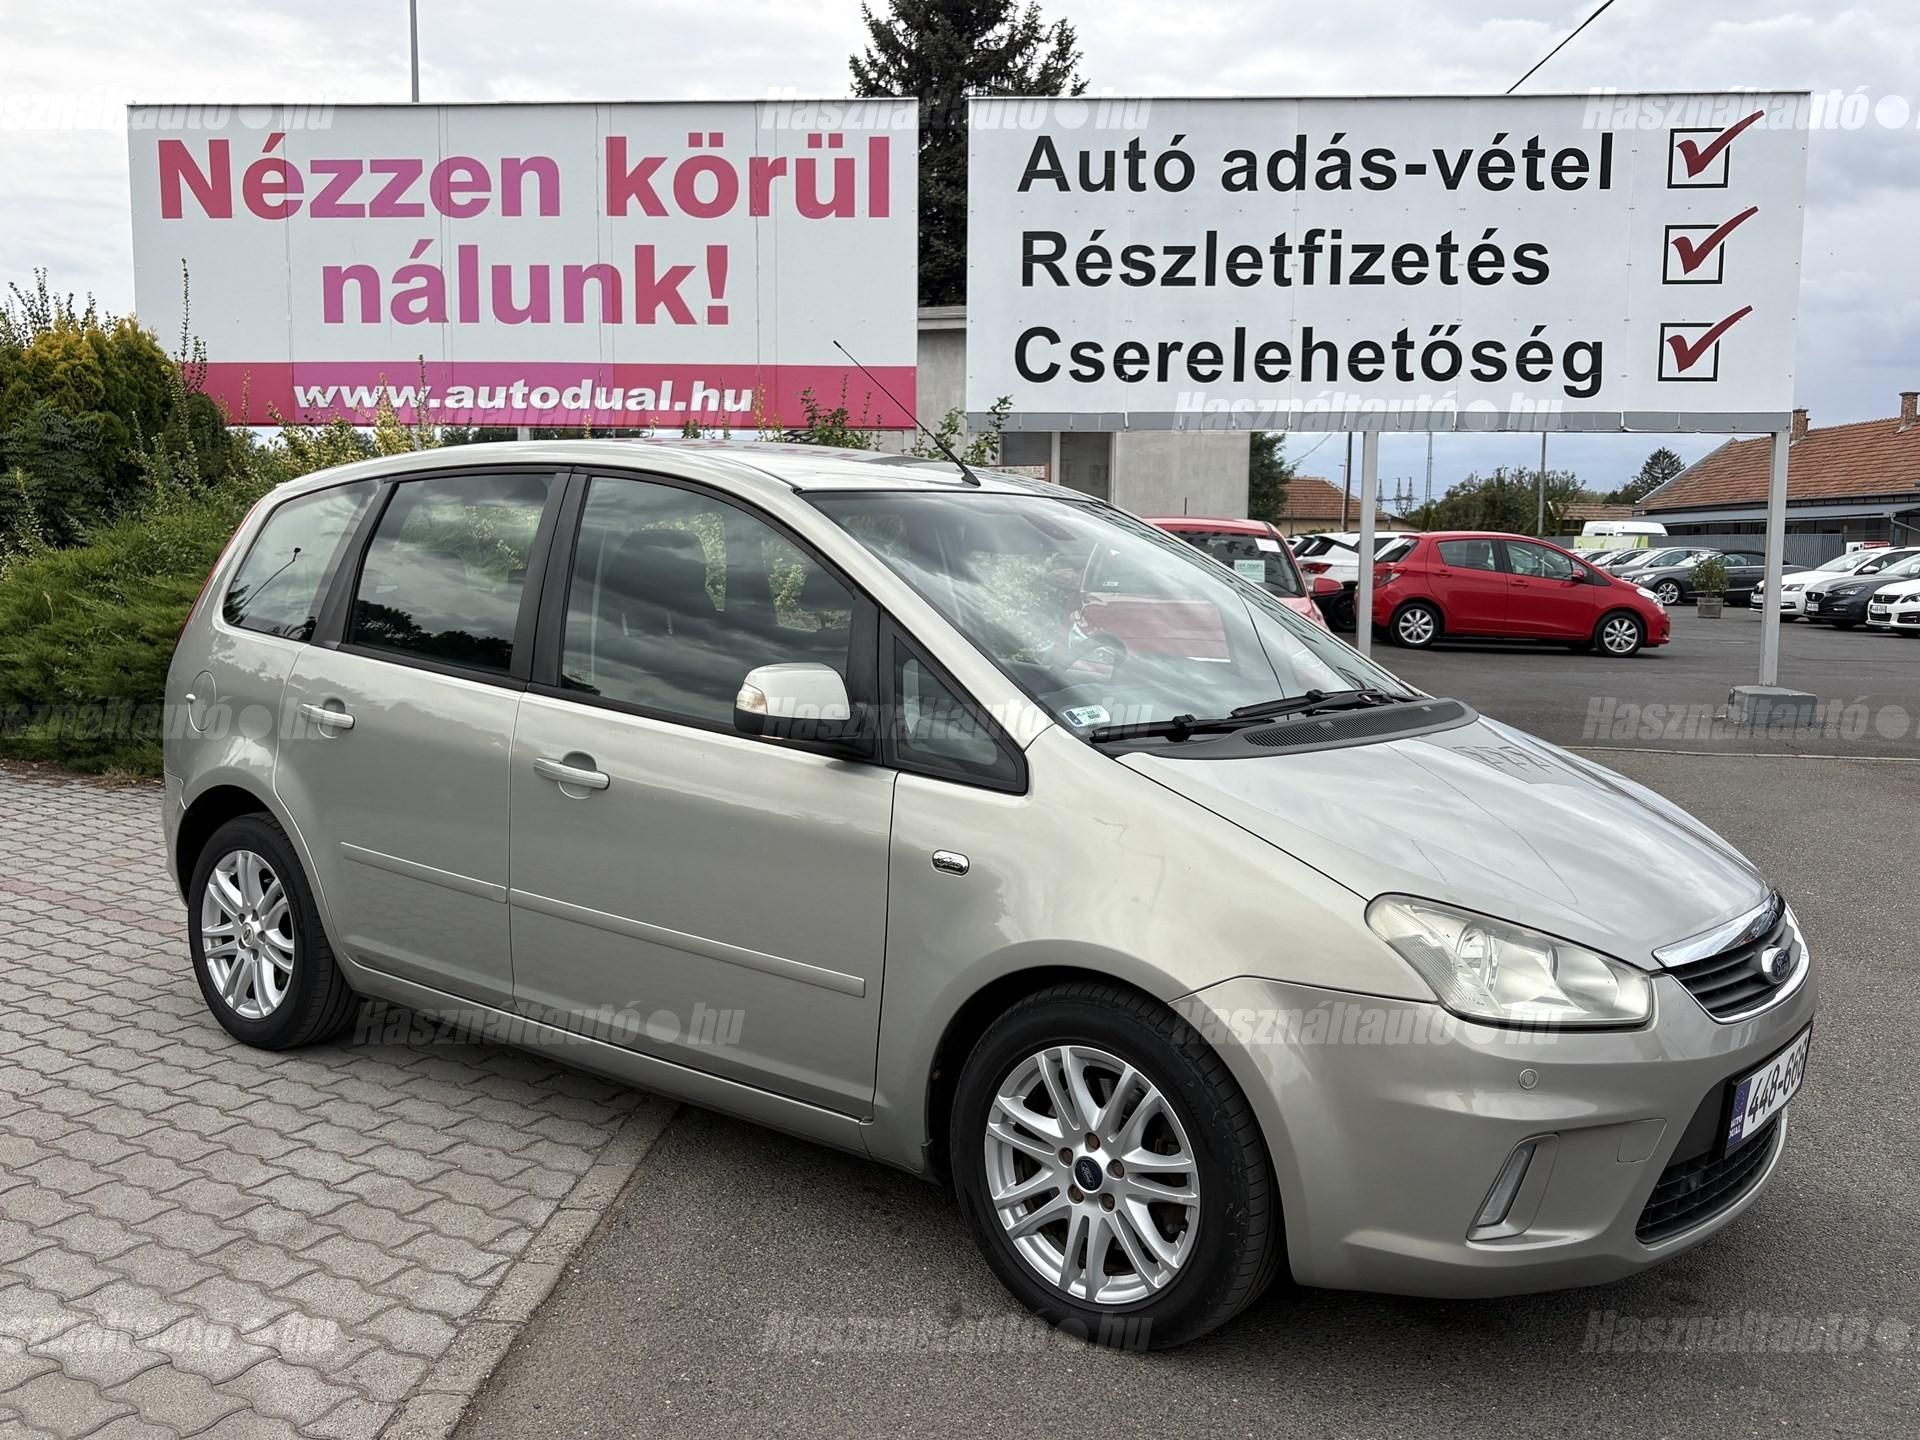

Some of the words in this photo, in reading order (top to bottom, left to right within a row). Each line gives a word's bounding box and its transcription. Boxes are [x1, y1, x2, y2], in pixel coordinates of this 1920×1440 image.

[159, 133, 559, 219] Nézzen
[607, 133, 888, 218] körül
[1018, 135, 1194, 192] Autó
[1222, 133, 1613, 192] adás-vétel
[325, 241, 727, 324] nálunk!
[1023, 228, 1549, 287] Részletfizetés
[1015, 325, 1602, 398] Cserelehetőség
[293, 379, 752, 412] www.autodual.hu
